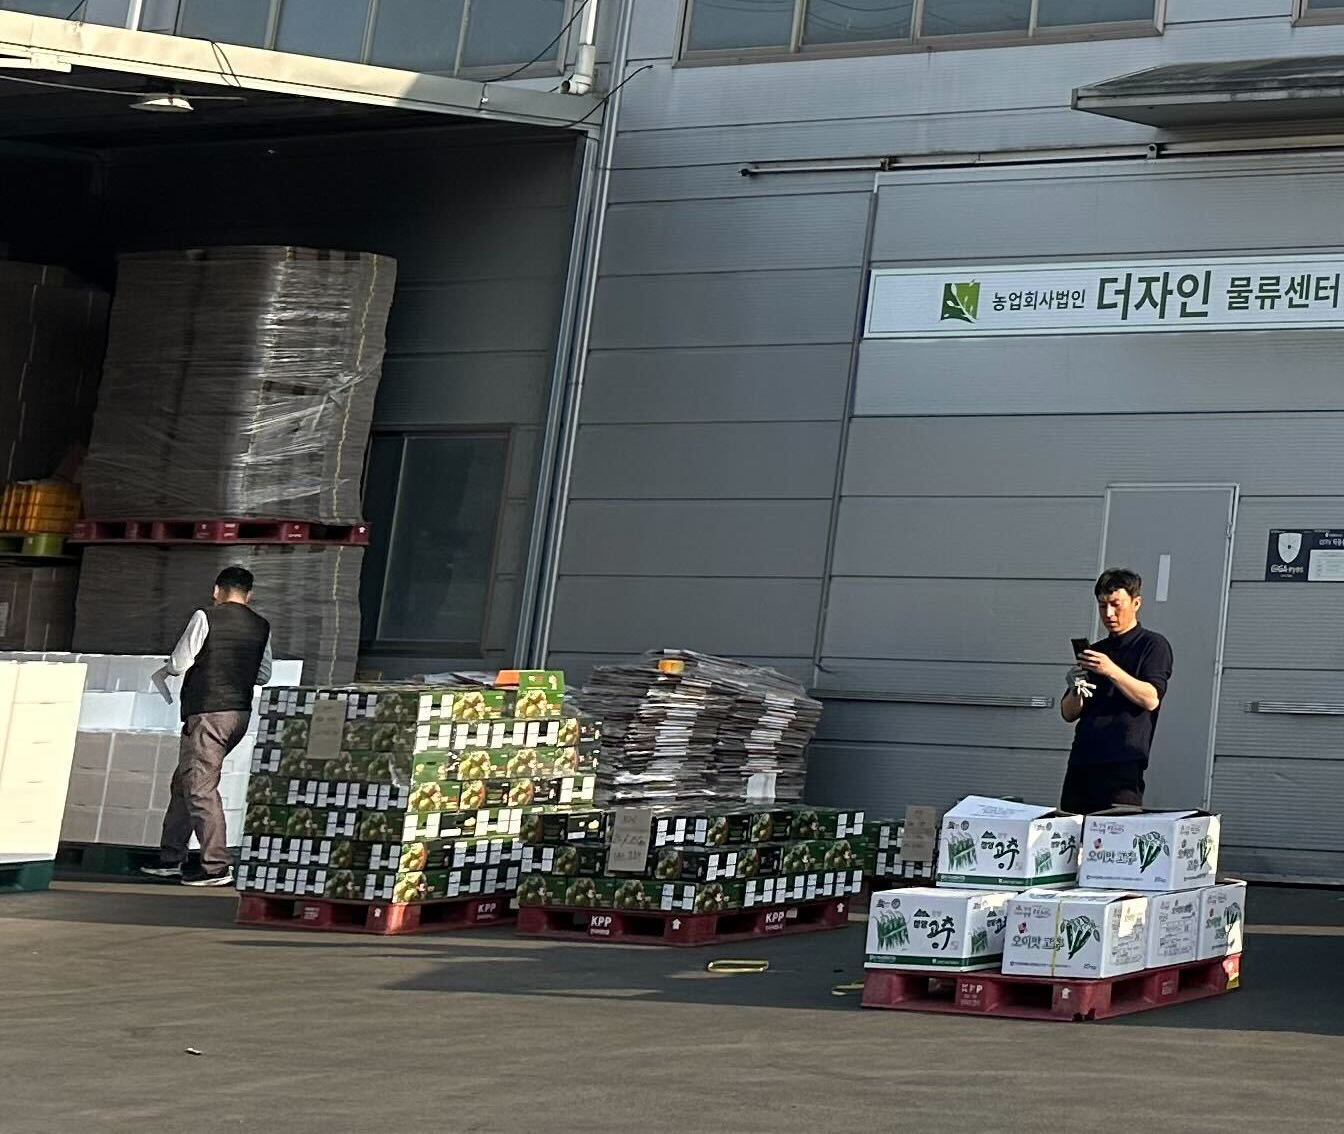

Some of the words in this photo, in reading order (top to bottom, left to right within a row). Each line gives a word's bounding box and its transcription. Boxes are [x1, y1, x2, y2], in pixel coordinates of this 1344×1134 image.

[992, 289, 1086, 312] 농업회사법인
[1097, 270, 1212, 320] 더자인
[1226, 273, 1340, 311] 물류센터
[477, 902, 497, 913] KPP
[590, 915, 612, 927] KPP
[765, 911, 785, 924] KPP
[1011, 935, 1041, 950] 오이맛
